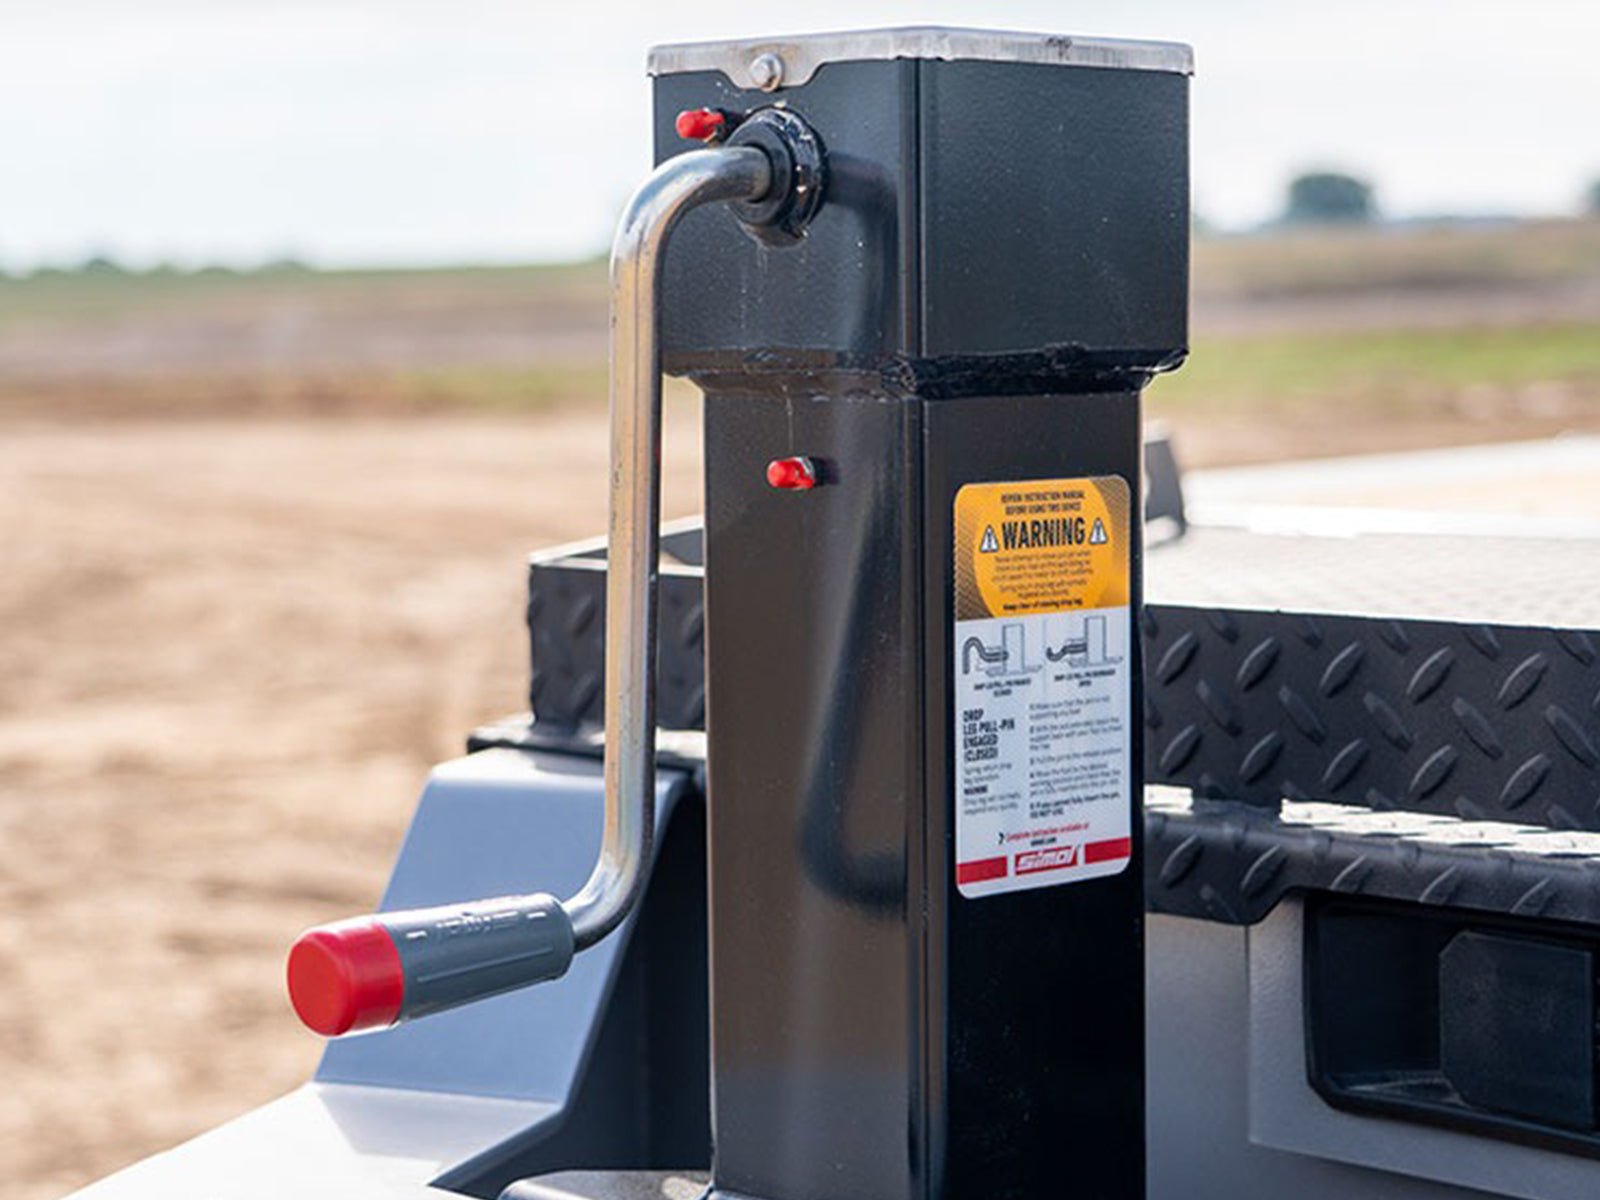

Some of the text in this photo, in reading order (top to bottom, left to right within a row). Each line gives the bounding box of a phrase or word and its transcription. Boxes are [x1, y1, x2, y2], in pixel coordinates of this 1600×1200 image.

[1002, 517, 1085, 550] WARNING
[963, 708, 984, 722] DROP
[963, 722, 978, 735] LEG
[963, 734, 998, 749] ENGAGED
[964, 747, 998, 762] (CLOSED)
